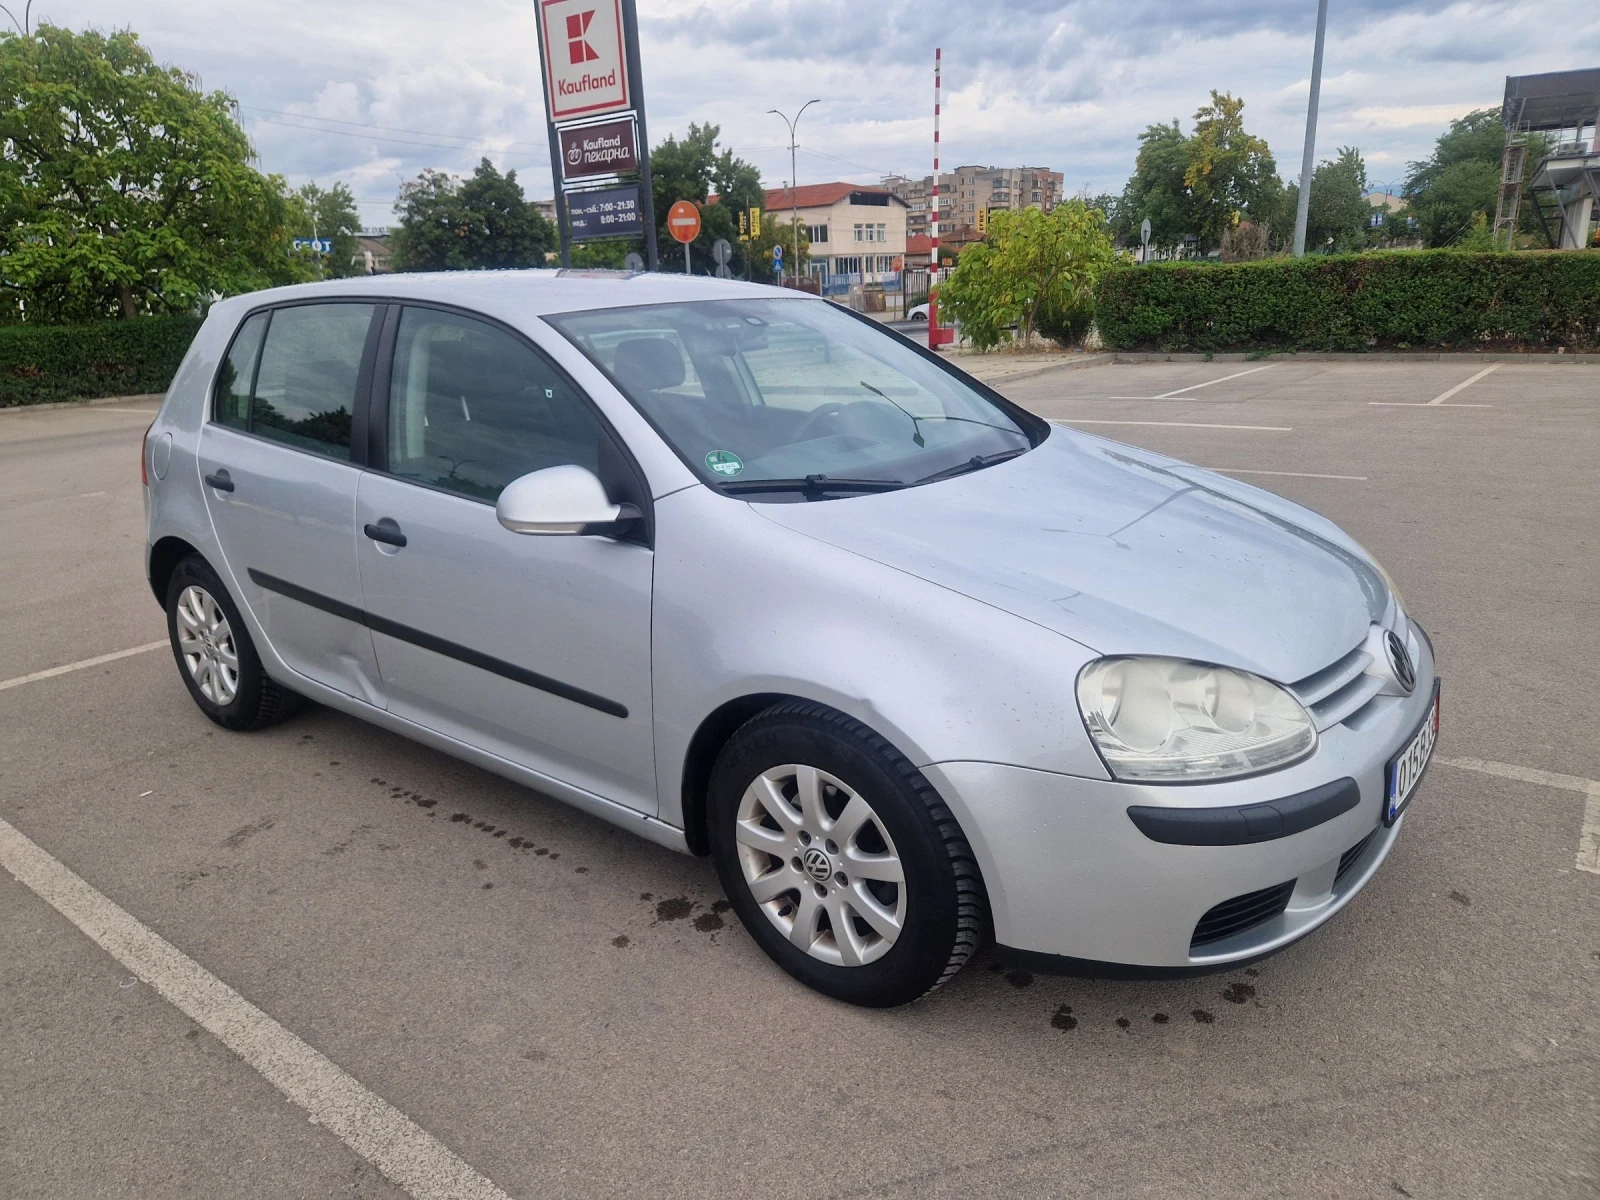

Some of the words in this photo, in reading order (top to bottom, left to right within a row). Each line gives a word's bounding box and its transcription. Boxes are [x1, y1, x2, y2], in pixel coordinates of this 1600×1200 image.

[558, 68, 616, 96] Kaufland
[583, 135, 621, 151] Kaufland
[584, 146, 631, 164] пекарна
